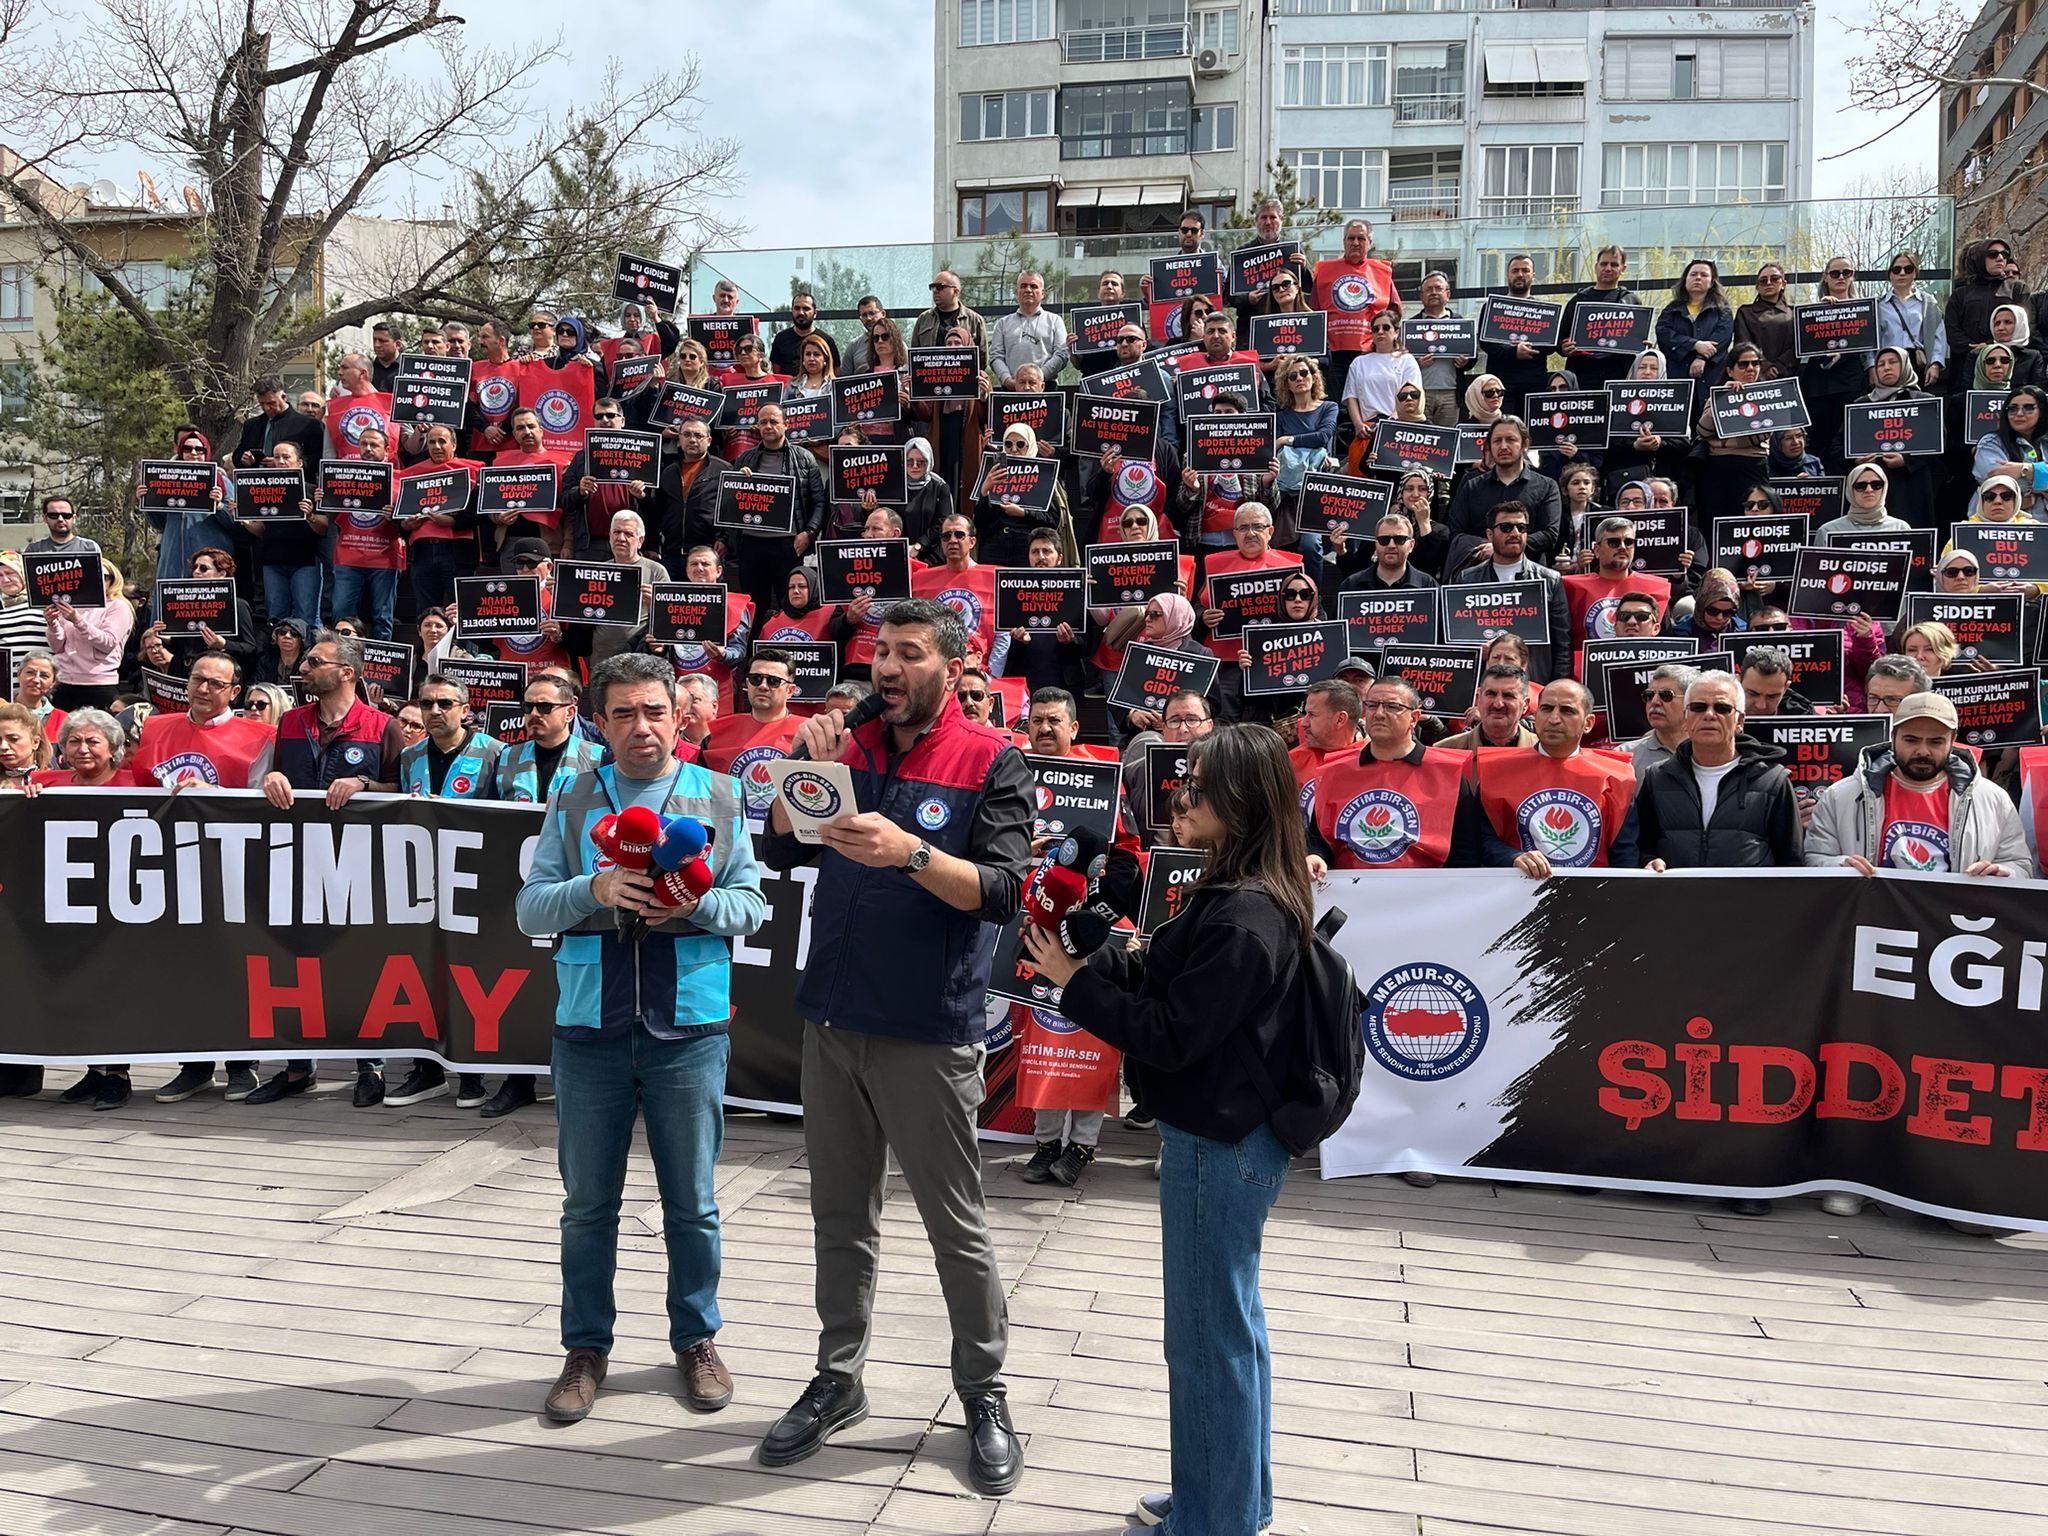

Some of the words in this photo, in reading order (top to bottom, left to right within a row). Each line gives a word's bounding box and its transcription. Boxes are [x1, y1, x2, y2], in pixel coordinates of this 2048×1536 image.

[1243, 249, 1282, 268] OKULDA
[631, 263, 642, 272] BU
[1166, 260, 1201, 270] NEREYE
[1177, 269, 1190, 277] BU
[1084, 311, 1124, 326] OKULDA
[1588, 311, 1634, 321] OKULDA
[703, 322, 738, 330] NEREYE
[1269, 318, 1308, 327] NEREYE
[1587, 321, 1633, 330] SİLAHIN
[715, 331, 728, 340] BU
[1280, 326, 1295, 334] BU
[1101, 369, 1141, 385] NEREYE
[844, 379, 882, 396] OKULDA
[1115, 380, 1133, 391] BU
[1621, 389, 1636, 398] BU
[1638, 389, 1674, 399] GİDİŞE
[1728, 394, 1744, 403] BU
[1746, 389, 1782, 401] GİDİŞE
[1003, 399, 1047, 413] OKULDA
[1542, 402, 1557, 411] BU
[1560, 401, 1594, 410] GİDİŞE
[1719, 409, 1740, 418] DUR
[1759, 400, 1797, 412] DİYELİM
[1003, 409, 1047, 423] SİLAHIN
[1091, 407, 1138, 422] ŞİDDET
[1868, 407, 1918, 419] NEREYE
[1883, 419, 1903, 428] BU
[1098, 431, 1127, 441] DEMEK
[1395, 431, 1440, 447] ŞİDDET
[1875, 429, 1912, 442] GİDİŞ
[843, 453, 887, 467] OKULDA
[1400, 449, 1429, 460] DEMEK
[844, 464, 888, 479] SİLAHIN
[417, 477, 453, 491] NEREYE
[864, 475, 884, 486] NE?
[426, 487, 442, 497] BU
[501, 489, 533, 499] BÜYÜK
[1011, 484, 1032, 492] NE?
[1307, 485, 1344, 495] OKULDA
[1346, 488, 1384, 500] ŞİDDETE
[739, 501, 769, 512] BÜYÜK
[1320, 496, 1365, 511] ÖFKEMİZ
[1323, 506, 1358, 518] BÜYÜK
[1734, 528, 1750, 537] BU
[1753, 526, 1790, 537] GİDİŞE
[1978, 530, 2034, 541] NEREYE
[1637, 536, 1679, 546] DİYELİM
[1995, 541, 2016, 551] BU
[839, 548, 886, 558] NEREYE
[1720, 546, 1741, 555] DUR
[1092, 554, 1130, 564] OKULDA
[1132, 552, 1172, 563] ŞİDDETE
[1986, 553, 2027, 565] GİDİŞ
[36, 559, 81, 575] OKULDA
[854, 559, 872, 570] BU
[1819, 560, 1840, 571] BU
[1843, 561, 1888, 574] GİDİŞE
[576, 570, 621, 581] NEREYE
[1108, 565, 1155, 577] ÖFKEMİZ
[37, 570, 82, 586] SİLAHIN
[846, 572, 882, 584] GİDİŞ
[1114, 575, 1150, 586] BÜYÜK
[42, 584, 57, 595] İŞİ
[58, 580, 79, 591] NE?
[589, 581, 606, 592] BU
[1001, 580, 1040, 588] OKULDA
[1042, 580, 1080, 589] ŞİDDETE
[1800, 579, 1826, 588] DUR
[1853, 581, 1898, 591] DİYELİM
[481, 596, 513, 607] BÜYÜK
[579, 594, 614, 606] GİDİŞ
[1016, 591, 1063, 602] ÖFKEMİZ
[1465, 592, 1522, 607] ŞİDDET
[477, 605, 518, 616] ÖFKEMİZ
[1022, 600, 1057, 611] BÜYÜK
[1242, 606, 1274, 615] DEMEK
[1360, 600, 1414, 614] ŞİDDET
[671, 613, 701, 624] BÜYÜK
[1475, 609, 1489, 618] VE
[1491, 608, 1537, 617] GÖZYAŞI
[1933, 606, 1995, 620] ŞİDDET
[1369, 616, 1381, 624] VE
[1384, 615, 1427, 624] GÖZYAŞI
[1477, 616, 1512, 625] DEMEK
[1960, 622, 2010, 633] GÖZYAŞI
[1263, 631, 1323, 651] OKULDA
[1263, 643, 1324, 666] SİLAHIN
[1589, 650, 1635, 661] OKULDA
[1146, 654, 1196, 673] NEREYE
[1268, 664, 1289, 677] İŞİ
[1292, 656, 1320, 671] NE?
[1387, 656, 1427, 666] OKULDA
[1429, 658, 1473, 669] ŞİDDETE
[1156, 668, 1176, 682] BU
[1402, 670, 1452, 683] ÖFKEMİZ
[1990, 701, 2024, 713] KARŞI
[1774, 728, 1853, 743] NEREYE
[1797, 744, 1828, 761] BU
[1043, 771, 1094, 789] GİDİŞE
[1055, 795, 1108, 810] DİYELİM
[44, 809, 484, 933] EĞİTİMDE
[1373, 968, 1476, 1004] MEMUR-SEN
[246, 954, 531, 1052] HAY
[1369, 1014, 1382, 1048] MEMUR
[1431, 1016, 1482, 1076] KONFEDERASYONU
